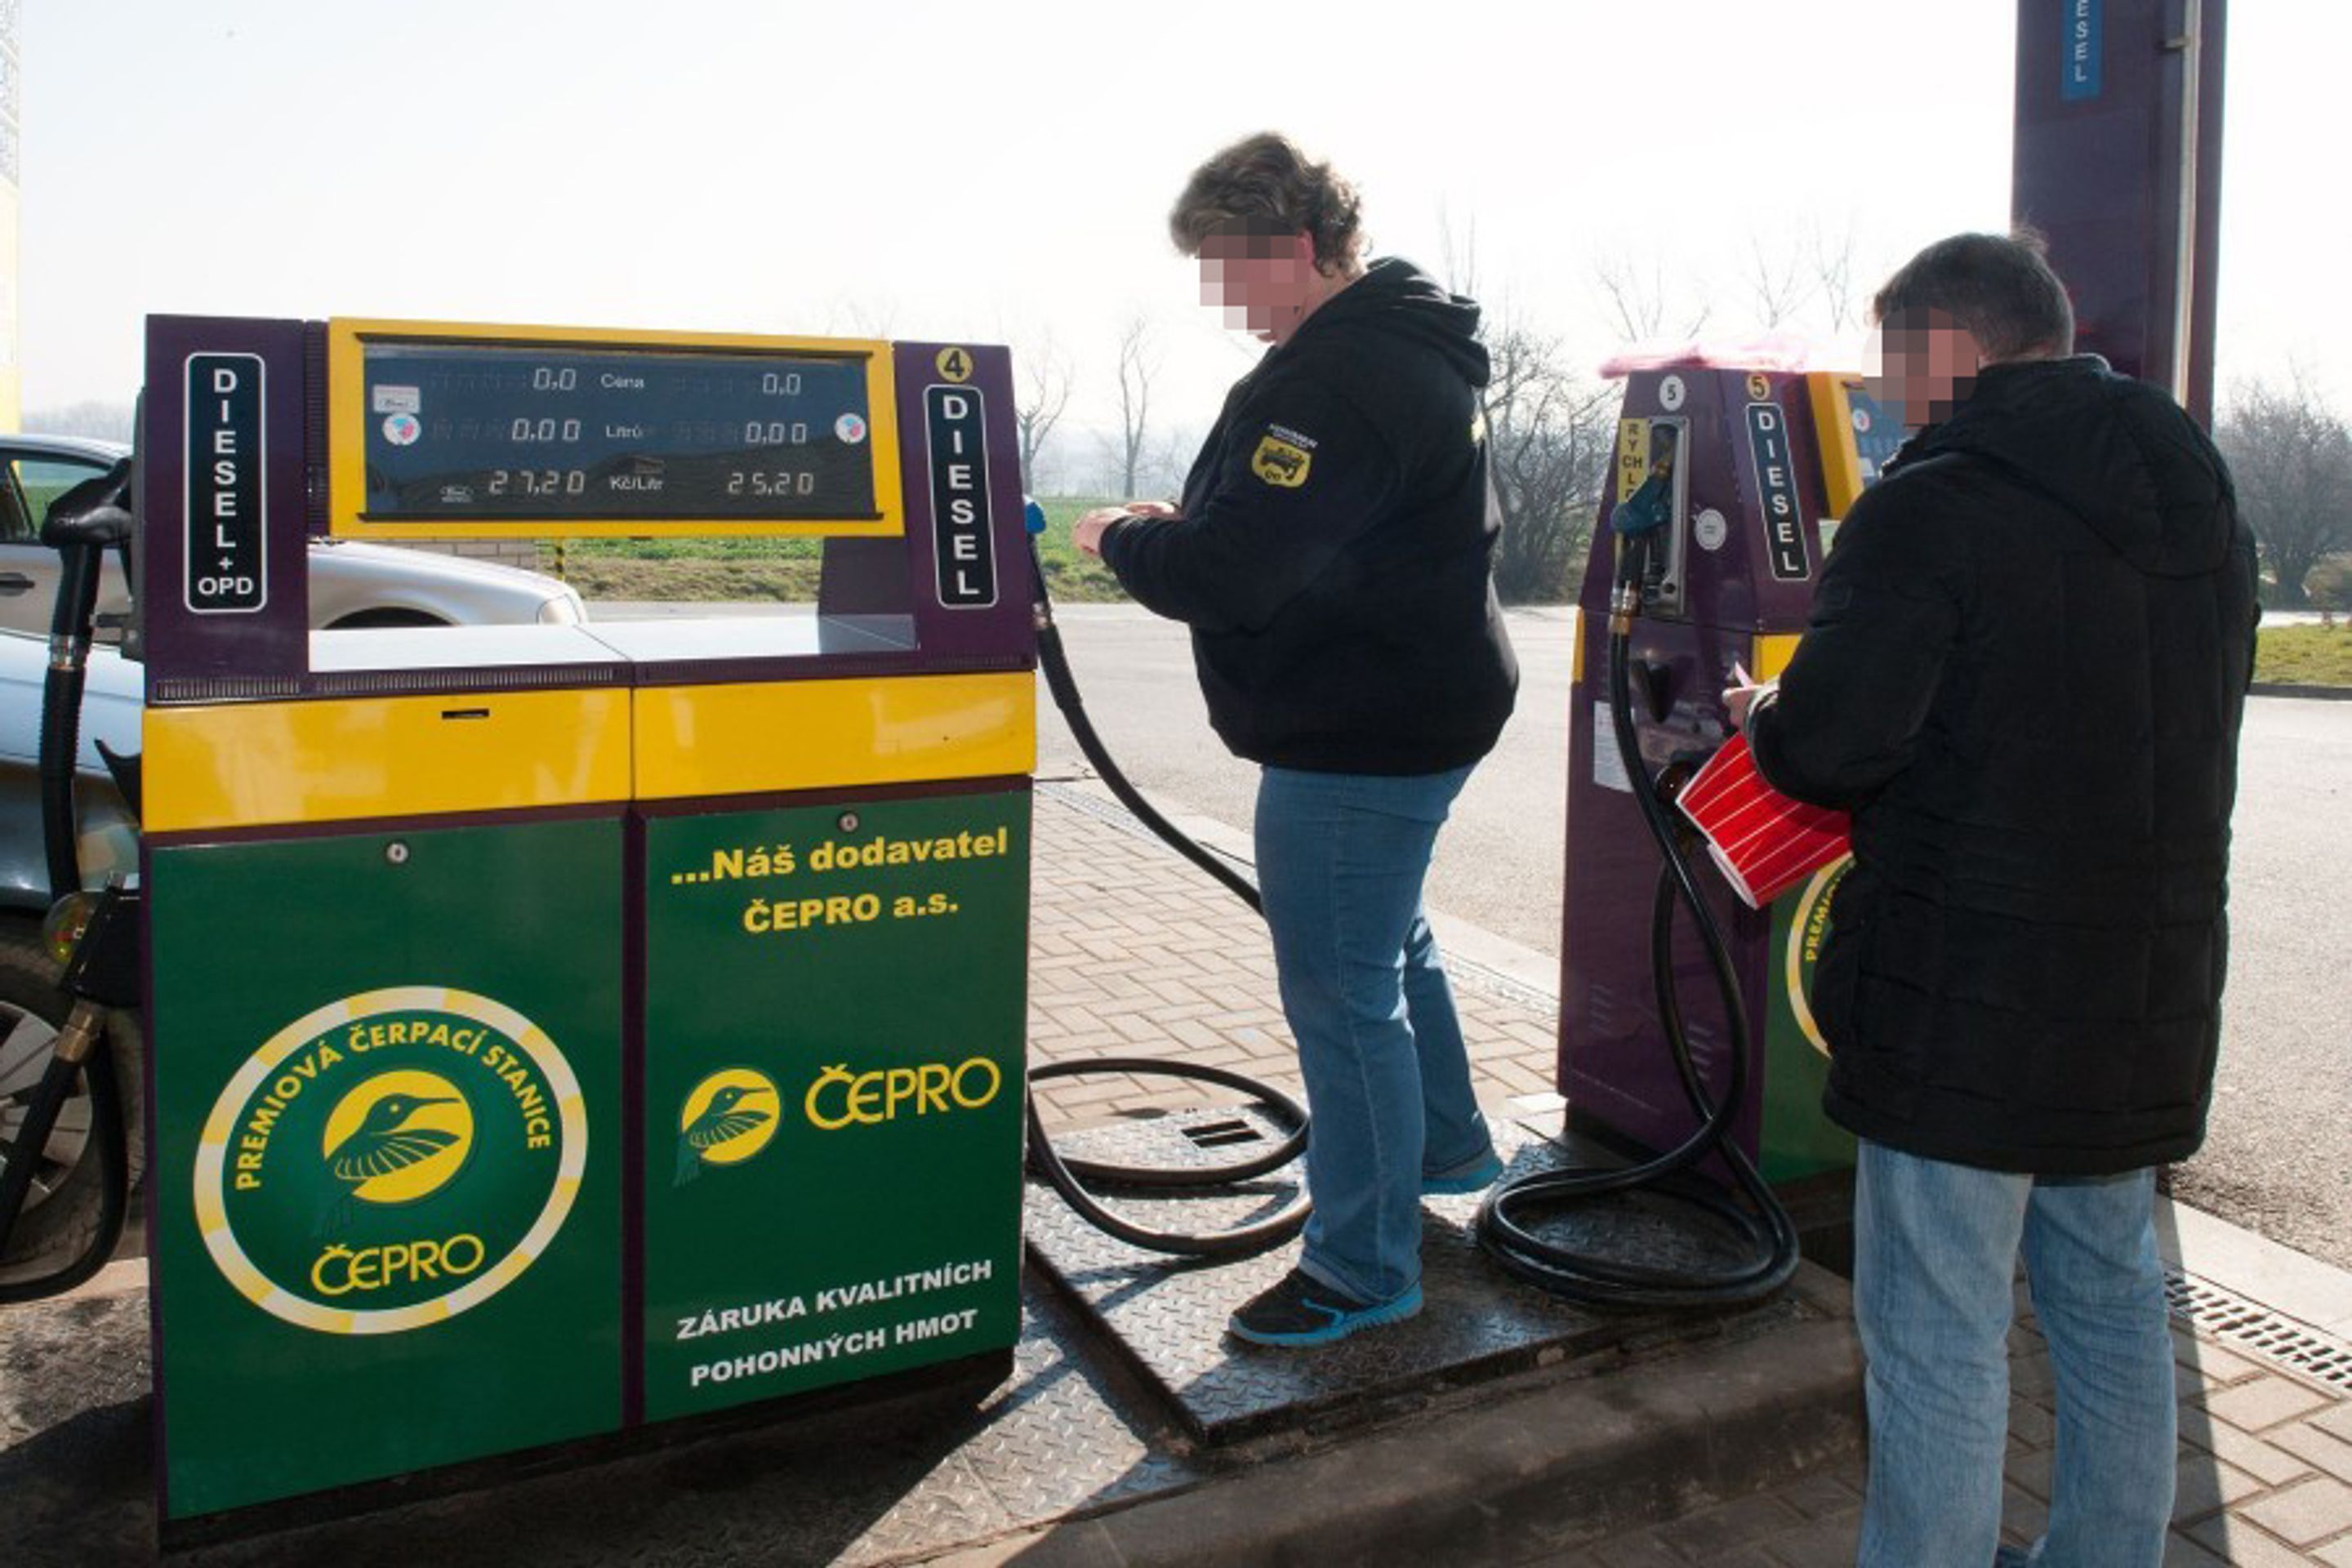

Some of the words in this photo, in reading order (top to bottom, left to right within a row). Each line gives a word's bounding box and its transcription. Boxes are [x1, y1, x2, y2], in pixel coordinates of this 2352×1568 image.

[600, 373, 644, 389] Cena
[945, 350, 964, 378] 4
[1751, 375, 1766, 399] 5
[1666, 383, 1677, 402] 5
[213, 368, 238, 549] DIESEL
[609, 475, 663, 490] Kč/Litr
[942, 395, 980, 595] DIESEL
[1758, 412, 1799, 572] DIESEL
[198, 577, 255, 596] OPD
[809, 826, 1009, 871] dodavatel
[743, 893, 881, 933] ČEPRO
[893, 892, 959, 918] a.s.
[234, 1040, 345, 1192] PREMIOVÁ
[349, 1022, 488, 1055] ČERPACÍ
[481, 1046, 550, 1150] STANICE
[804, 1057, 1002, 1130] ČEPRO
[310, 1233, 485, 1296] ČEPRO
[676, 1297, 806, 1340] ZÁRUKA
[816, 1258, 992, 1314] KVALITNÍCH
[690, 1328, 885, 1388] POHONNÝCH
[894, 1308, 978, 1344] HMOT
